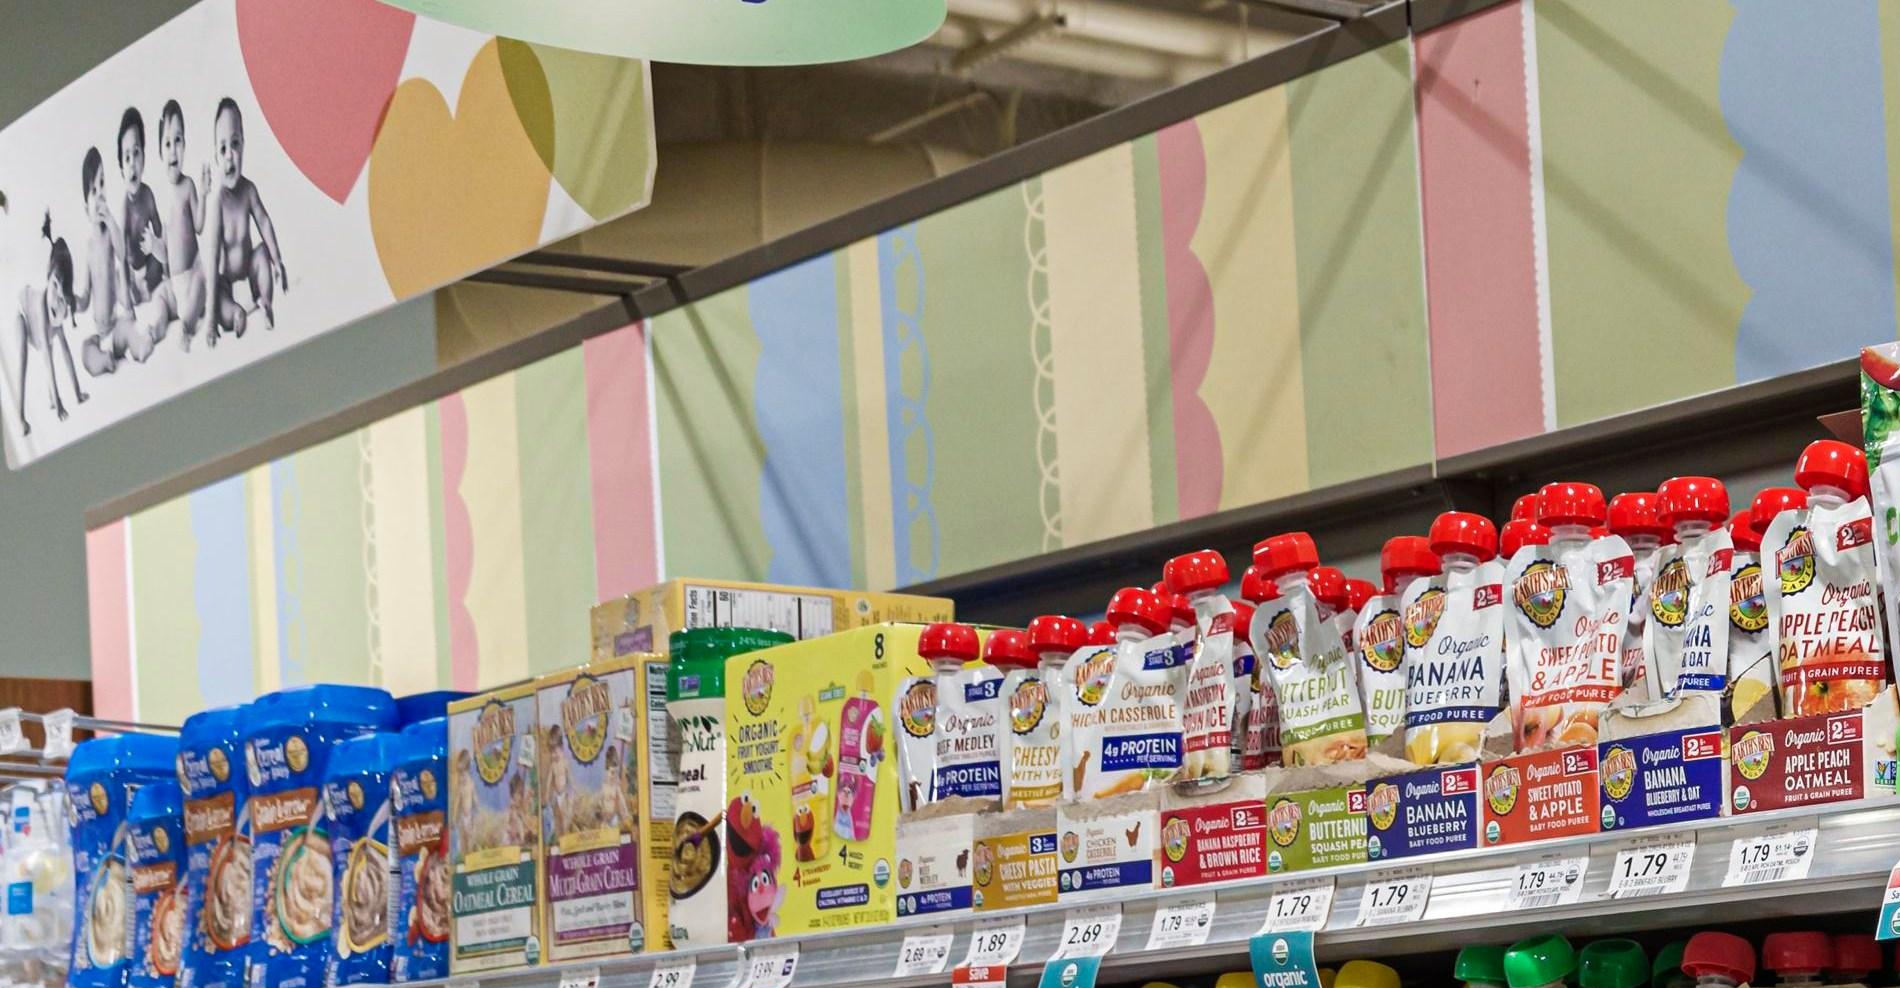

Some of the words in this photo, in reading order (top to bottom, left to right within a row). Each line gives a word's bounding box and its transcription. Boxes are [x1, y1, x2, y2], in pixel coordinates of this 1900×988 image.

[1808, 666, 1839, 678] GRAIN
[1842, 665, 1879, 676] PUREE
[1111, 705, 1176, 722] CASSEROLE
[955, 734, 995, 751] MEDLEY
[1121, 739, 1177, 754] PROTEIN
[1784, 731, 1825, 749] Organic
[1642, 748, 1680, 764] Organic
[1784, 755, 1816, 773] APPLE
[1818, 749, 1850, 770] PEACH
[1643, 767, 1687, 790] BANANA
[1407, 801, 1467, 824] BANANA
[1408, 821, 1467, 837] BLUEBERRY
[1740, 842, 1770, 863] 1.79
[1623, 854, 1667, 877] 1.79
[1371, 884, 1408, 908] 1.79
[1068, 923, 1101, 945] 2.69
